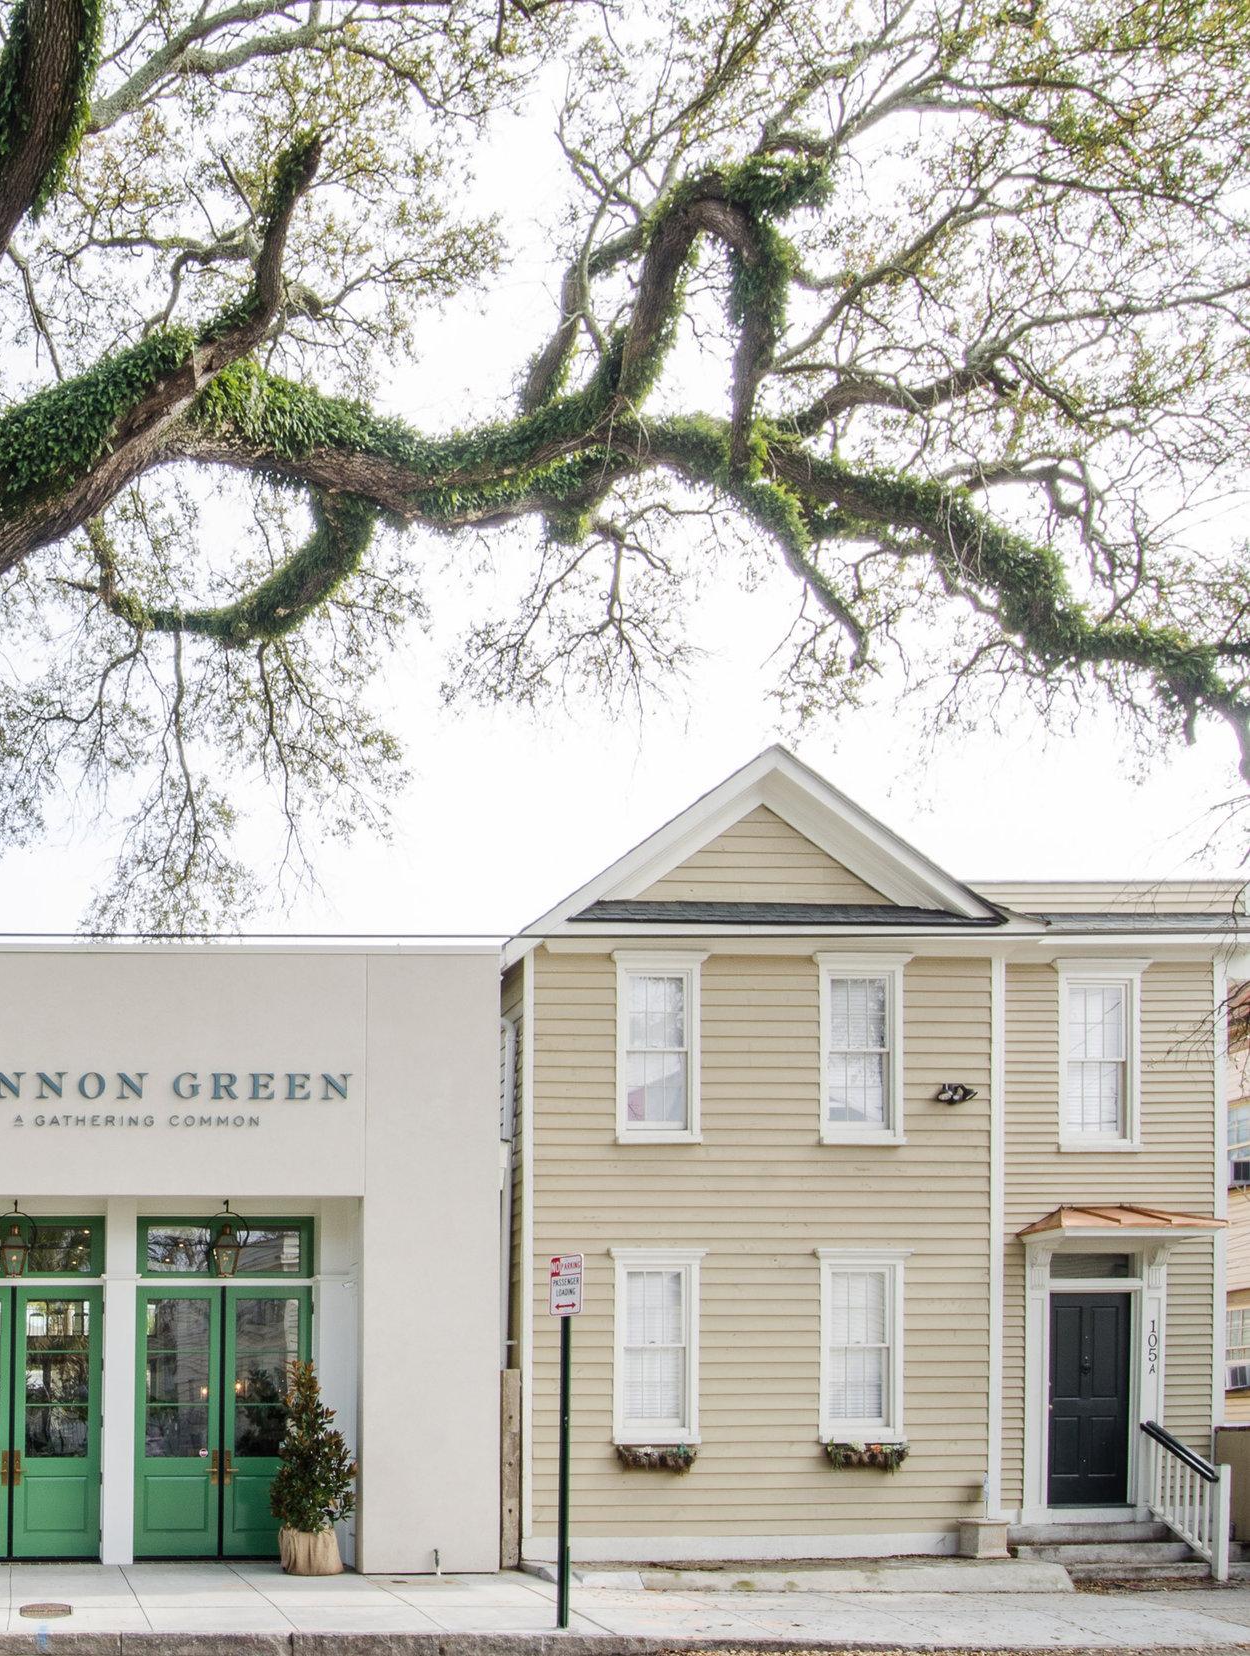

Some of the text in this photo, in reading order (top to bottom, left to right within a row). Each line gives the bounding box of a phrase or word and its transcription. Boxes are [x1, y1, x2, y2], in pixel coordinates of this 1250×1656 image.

[173, 1072, 353, 1100] GREEN
[13, 1115, 261, 1127] A GATHERING COMMON
[553, 1277, 579, 1287] PASSENGER
[556, 1288, 576, 1297] LOADING
